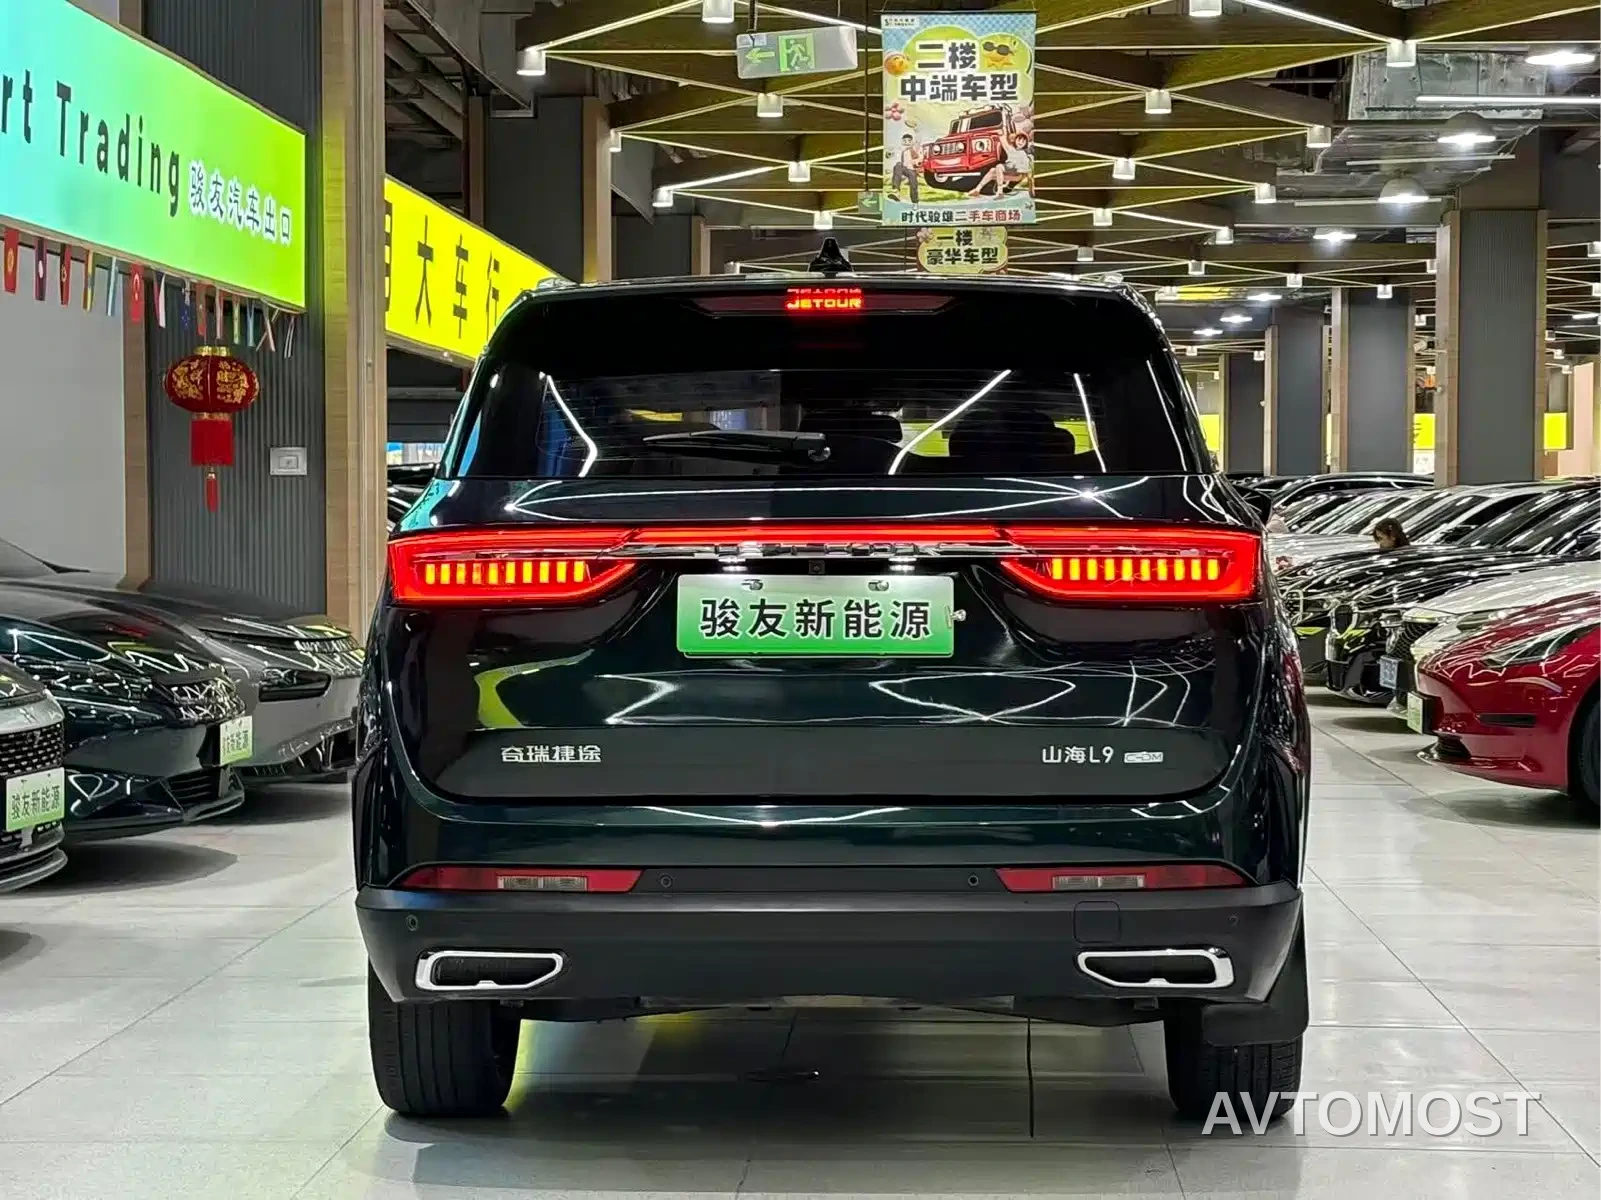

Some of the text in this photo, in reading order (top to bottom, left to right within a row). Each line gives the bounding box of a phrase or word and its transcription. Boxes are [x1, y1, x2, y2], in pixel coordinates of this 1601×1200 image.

[917, 41, 977, 70] 二楼
[900, 73, 1018, 102] 中端车型
[1, 68, 180, 217] rt Trading
[189, 162, 292, 243] 骏友汽车出口
[901, 209, 1021, 223] 时代骏雄二手车商场
[937, 229, 973, 246] 一楼
[927, 247, 998, 265] 豪华车型
[787, 298, 862, 309] JETOUR
[700, 598, 930, 639] 骏友新能源
[501, 745, 601, 763] 奇瑞捷途
[1042, 745, 1114, 763] 山海L9
